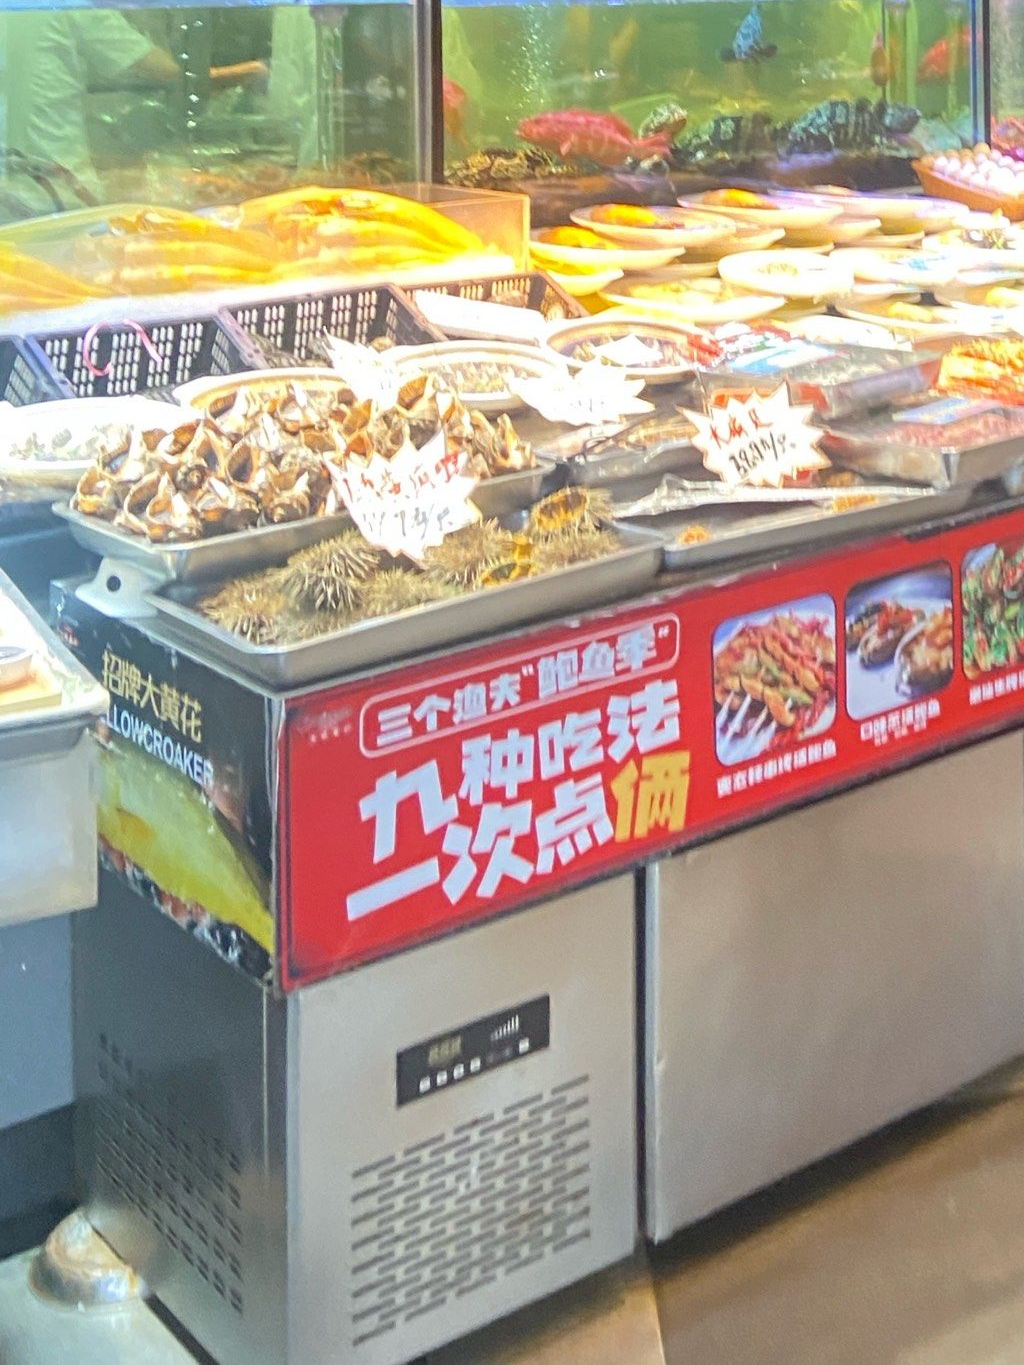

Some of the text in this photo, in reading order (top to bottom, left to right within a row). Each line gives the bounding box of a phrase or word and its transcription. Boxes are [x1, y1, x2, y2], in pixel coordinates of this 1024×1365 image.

[101, 646, 203, 744] 招牌大黄花
[104, 705, 216, 788] LLOWCROAKER
[346, 751, 692, 921] 一次点俩
[359, 680, 682, 865] 九种吃法
